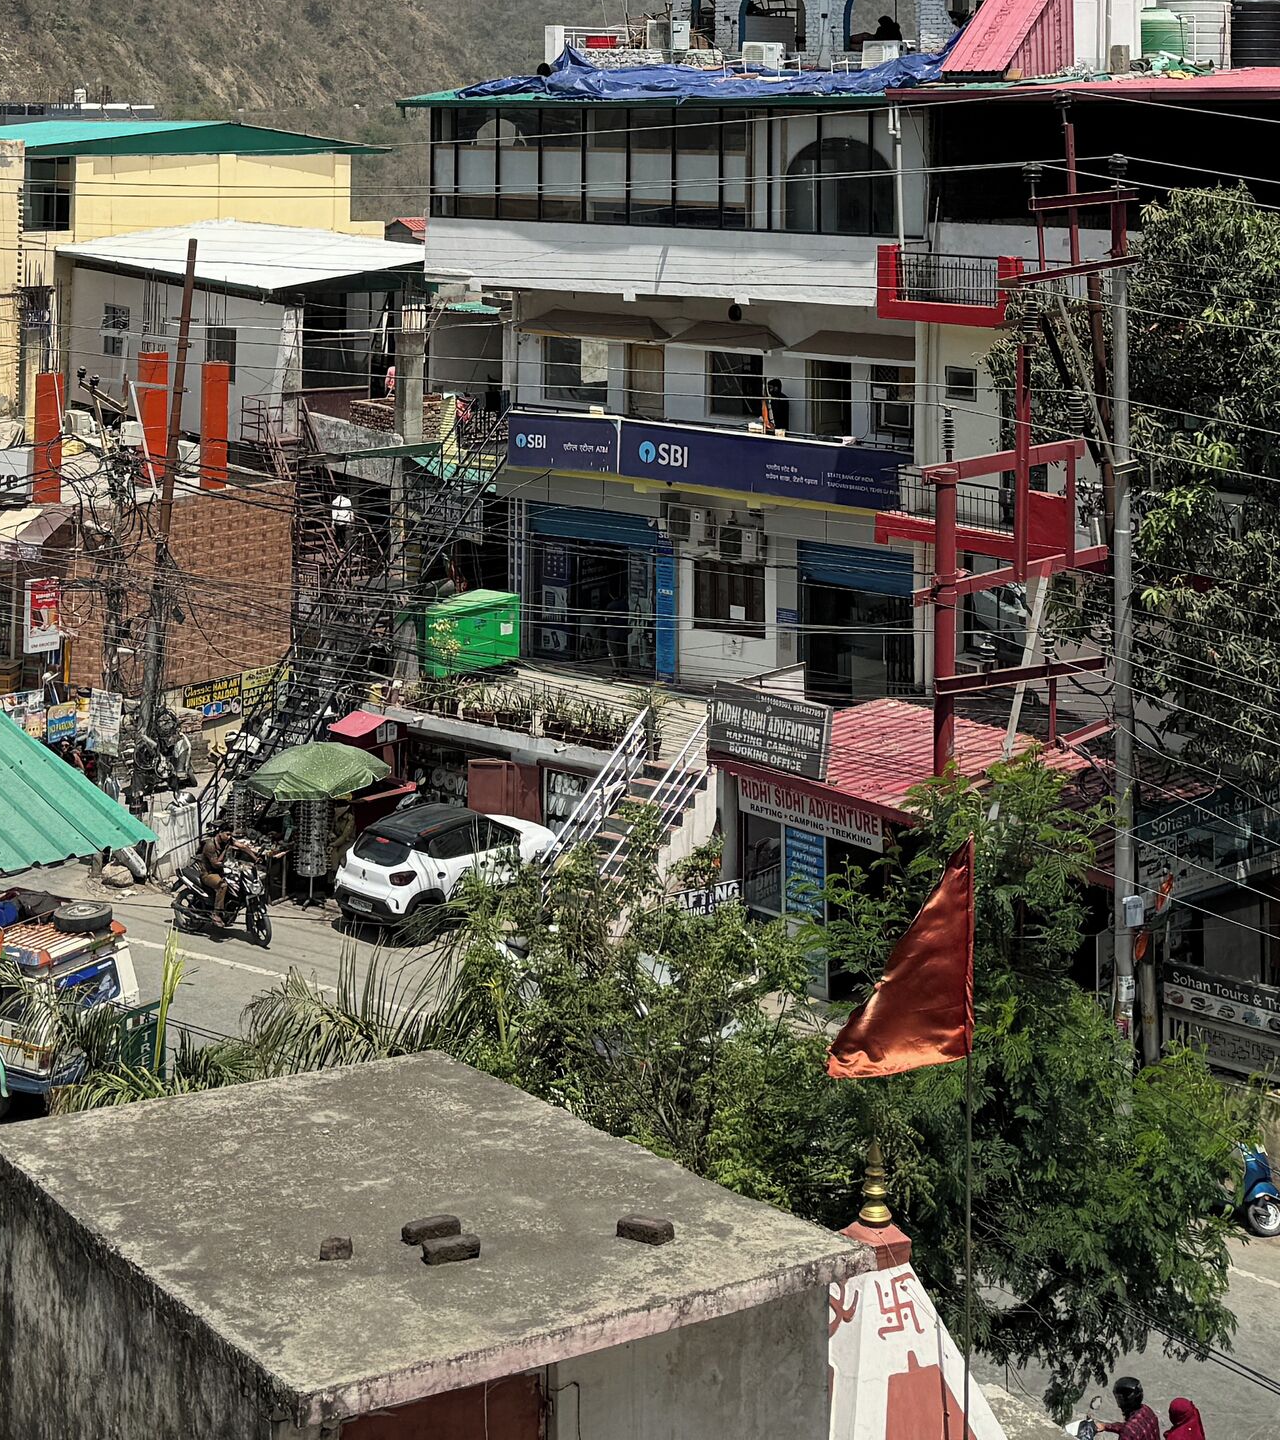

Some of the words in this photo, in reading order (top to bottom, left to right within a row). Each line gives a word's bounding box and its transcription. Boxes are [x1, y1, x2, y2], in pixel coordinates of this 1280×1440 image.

[527, 434, 547, 449] SBI
[657, 443, 689, 468] SBI
[827, 471, 841, 480] STATE
[841, 474, 855, 482] BANK
[184, 685, 212, 698] Classic
[212, 679, 228, 692] HAIR
[228, 677, 240, 688] ART
[186, 694, 211, 708] UNISEX
[715, 701, 740, 727] RIDHI
[741, 709, 767, 735] SIDHI
[767, 716, 821, 749] ADVENTURE
[725, 730, 763, 749] RAFTING
[766, 742, 808, 761] CAMPING
[728, 742, 769, 763] BOOKING
[769, 754, 802, 772] OFFICE
[741, 779, 771, 805] RIDHI
[774, 786, 805, 814] SIDHI
[808, 796, 879, 836] ADVENTURE
[1150, 812, 1192, 836] Sohan
[1233, 796, 1244, 811] &
[750, 802, 783, 819] RAFTING
[788, 813, 825, 832] CAMPING
[831, 825, 873, 846] TREKKING
[792, 830, 817, 842] TOURIST
[791, 851, 817, 864] RAFTING
[791, 862, 818, 875] CAMPING
[678, 882, 741, 909] AFTING
[1172, 971, 1212, 993] Sohan
[1213, 983, 1250, 1004] Tours
[1253, 994, 1263, 1007] &
